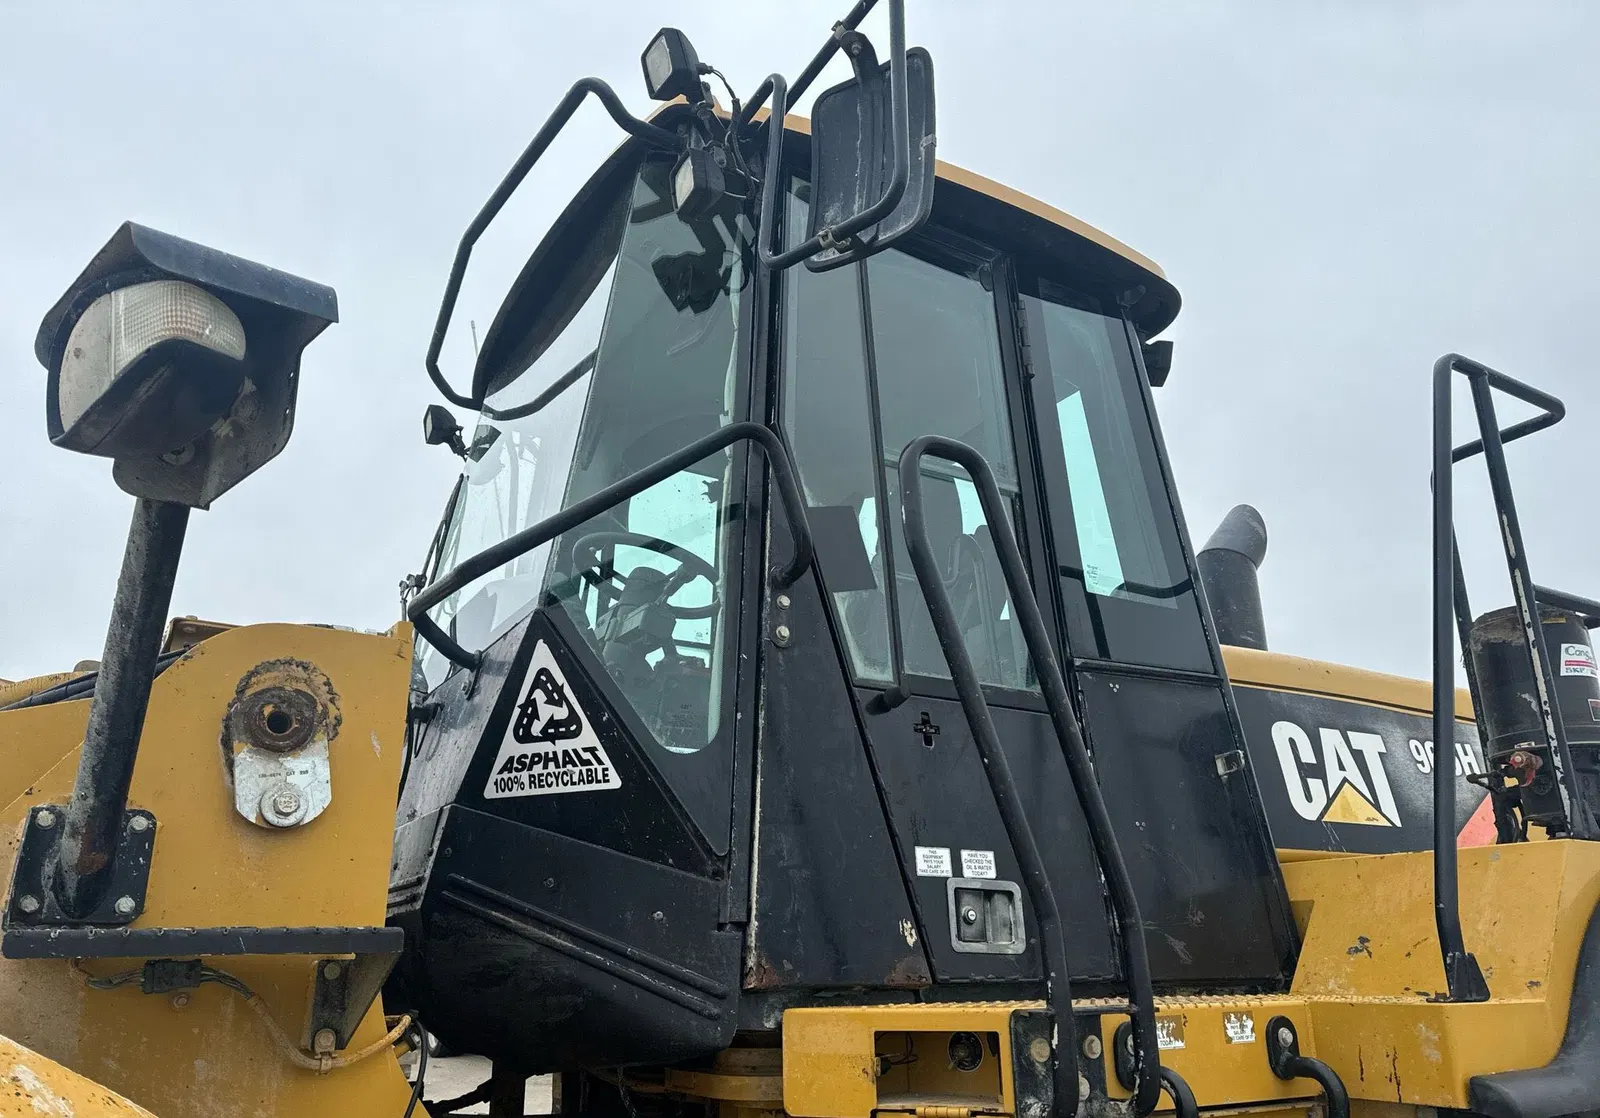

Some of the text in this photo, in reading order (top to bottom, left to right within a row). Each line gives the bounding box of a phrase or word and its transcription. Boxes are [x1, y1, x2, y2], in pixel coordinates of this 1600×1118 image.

[496, 746, 605, 775] ASPHALT
[1271, 720, 1402, 827] CAT
[1408, 739, 1481, 776] 9H
[494, 767, 610, 794] 100% RECYCLABLE
